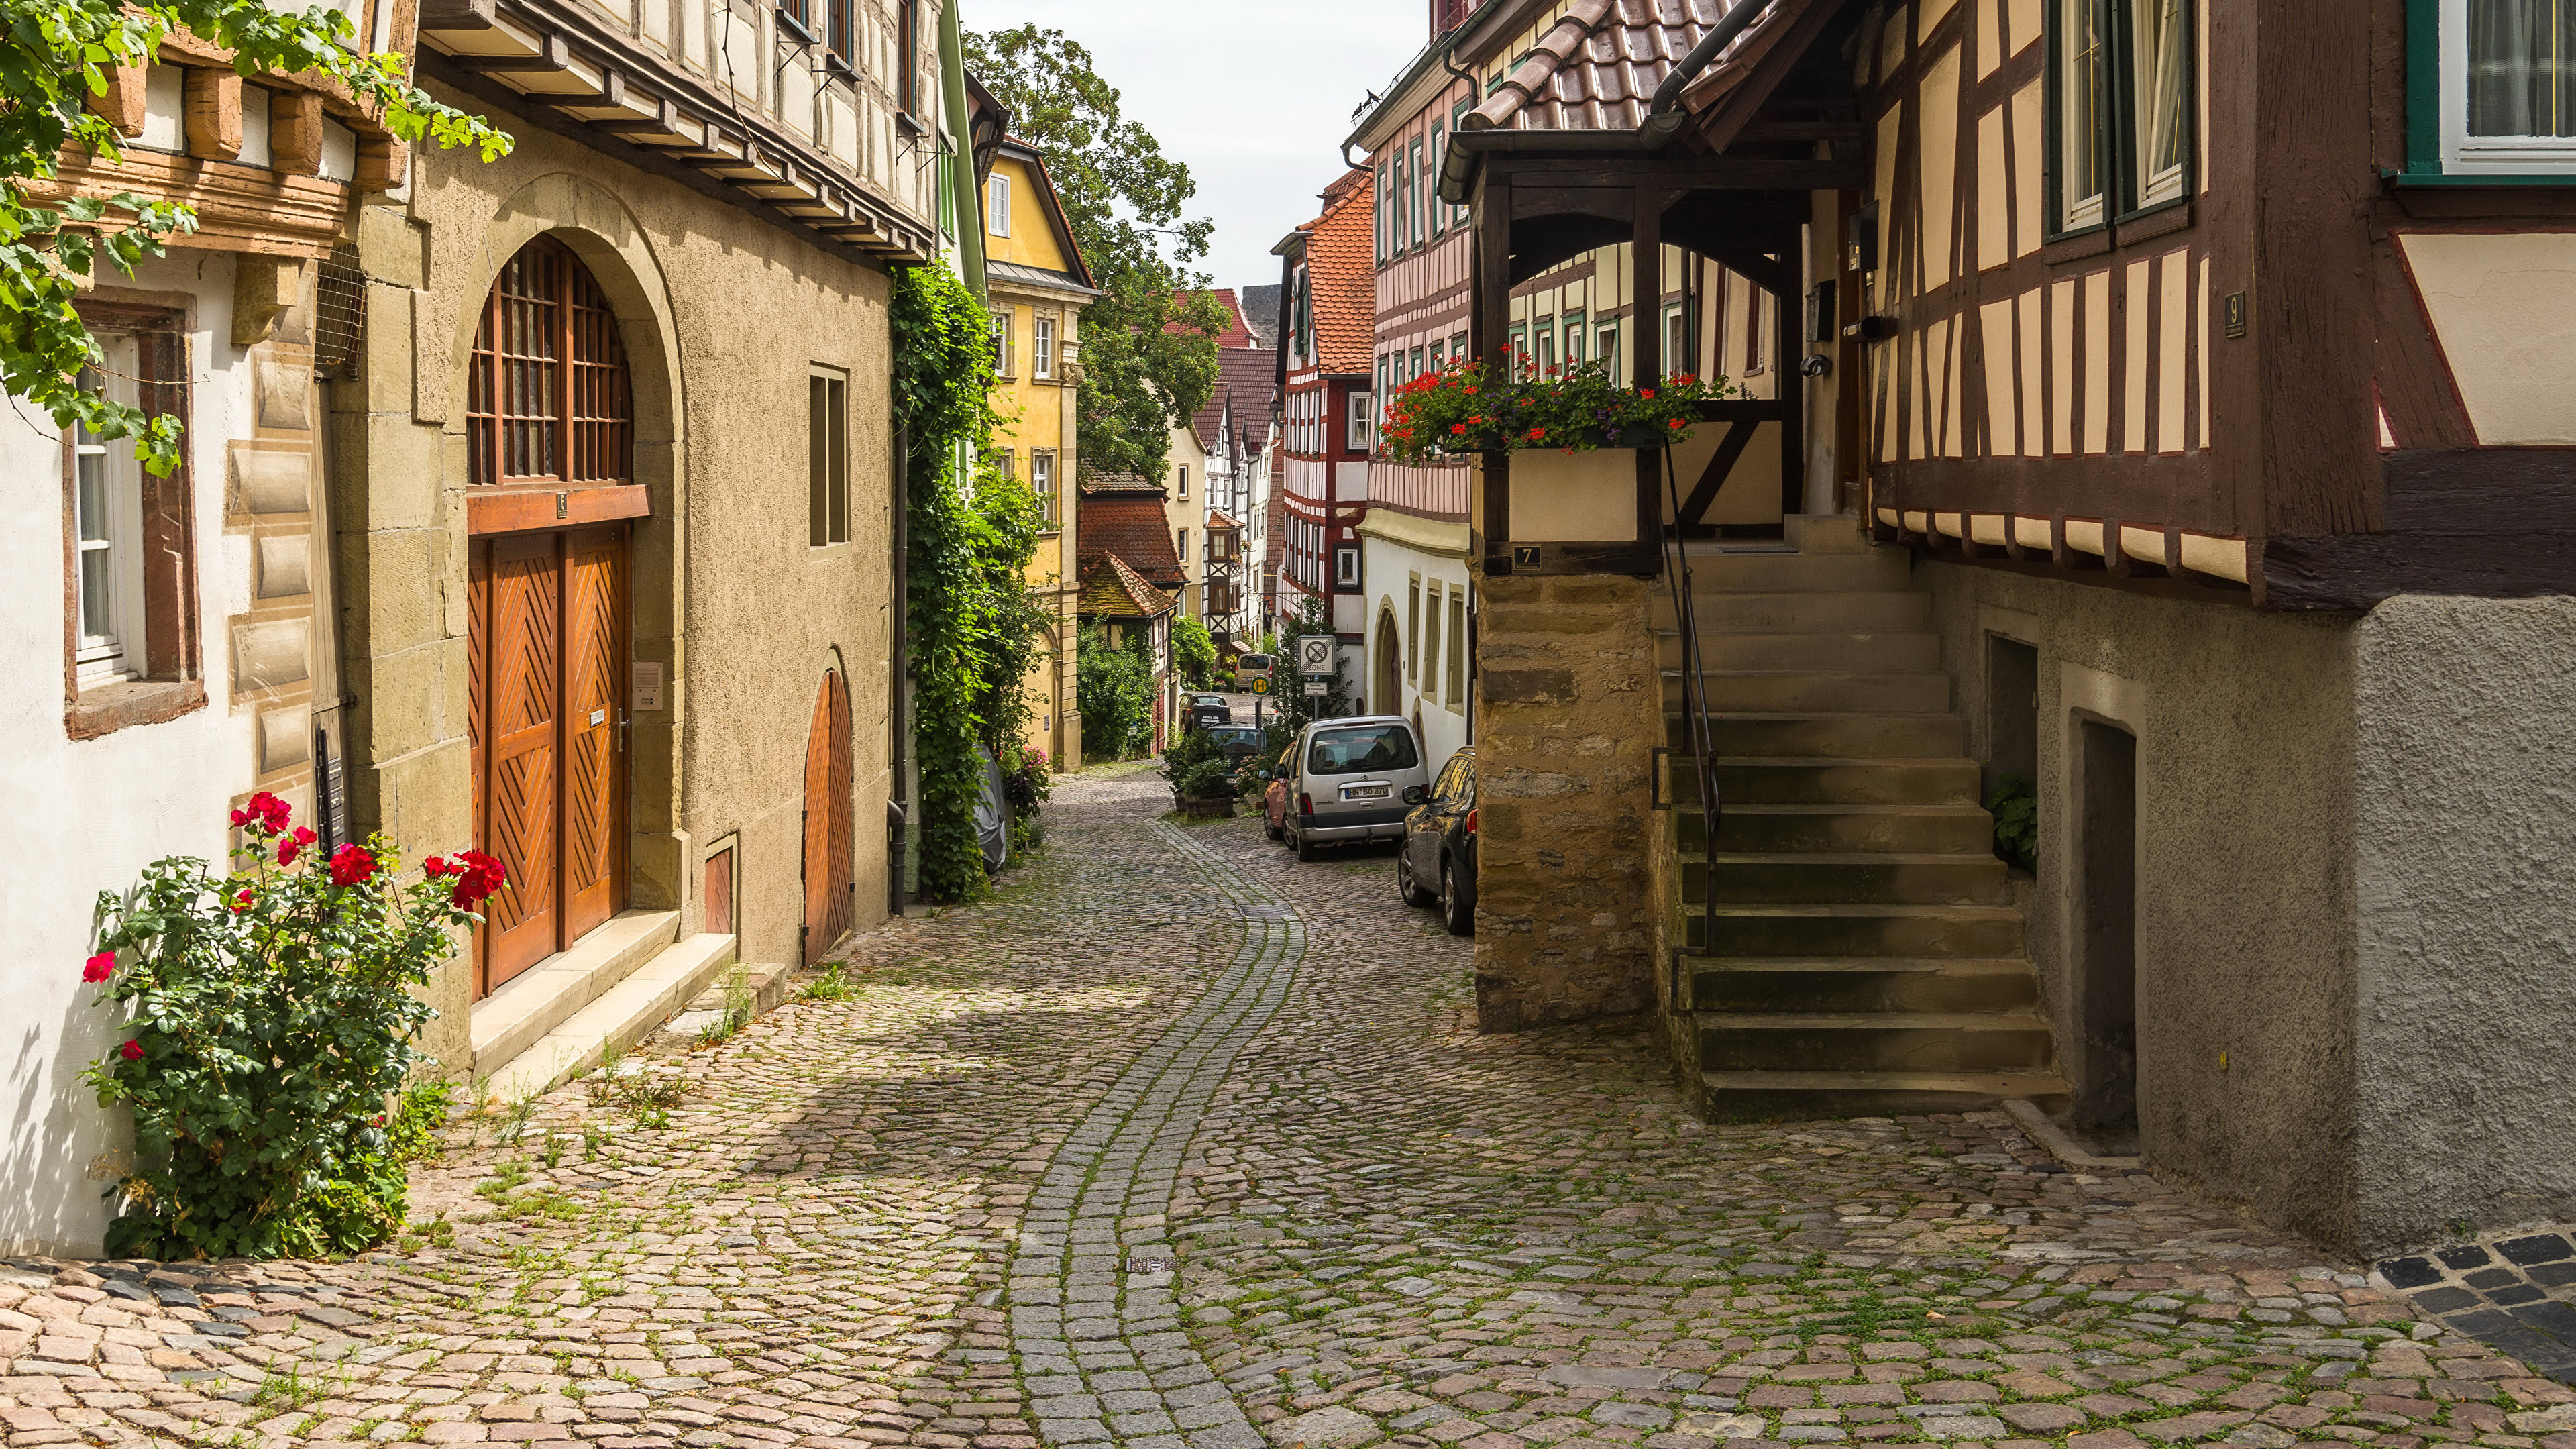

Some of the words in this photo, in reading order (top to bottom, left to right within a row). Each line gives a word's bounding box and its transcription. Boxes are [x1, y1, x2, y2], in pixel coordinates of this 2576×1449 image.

[2231, 297, 2237, 323] 9
[561, 494, 564, 510] 6
[1523, 548, 1532, 563] 7
[1256, 681, 1264, 691] H
